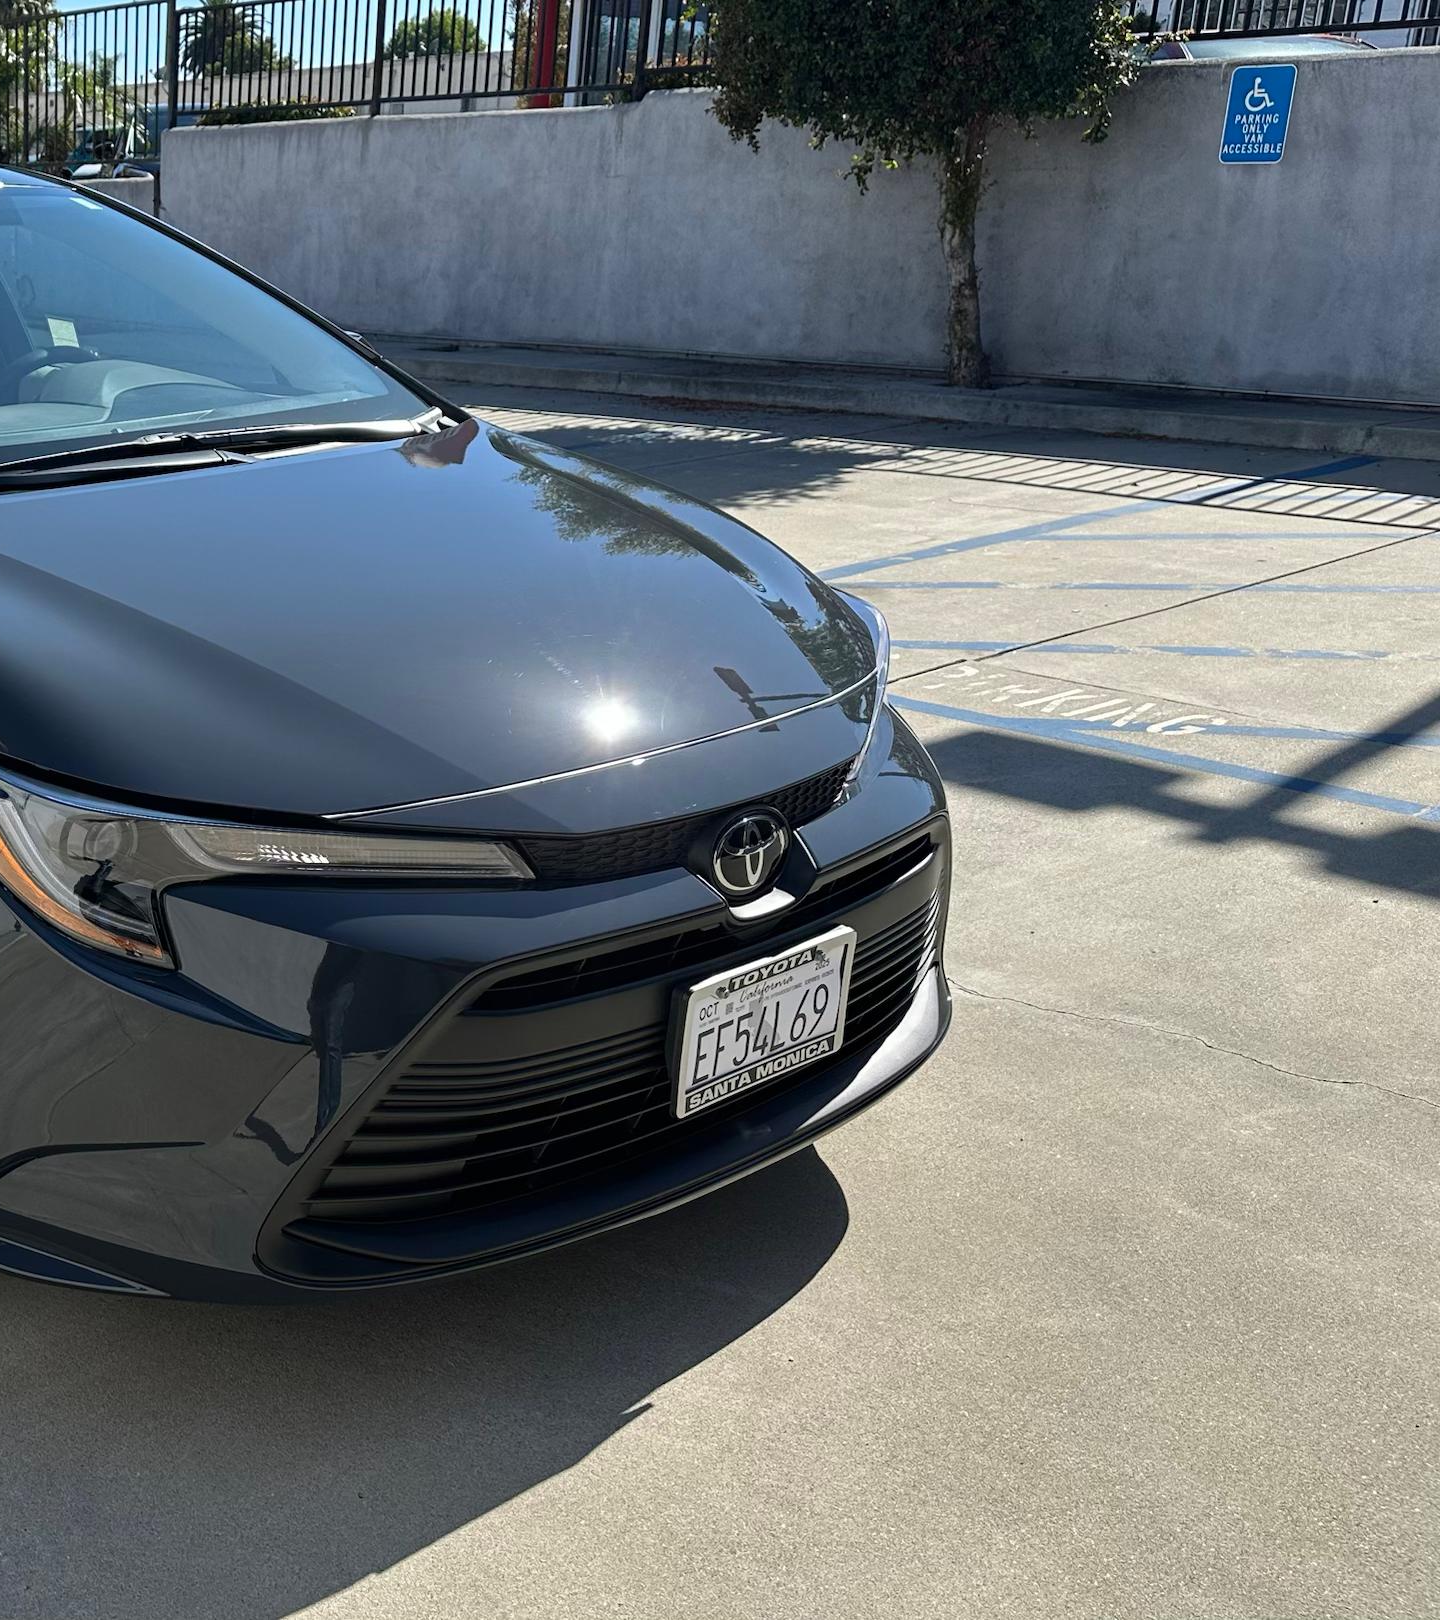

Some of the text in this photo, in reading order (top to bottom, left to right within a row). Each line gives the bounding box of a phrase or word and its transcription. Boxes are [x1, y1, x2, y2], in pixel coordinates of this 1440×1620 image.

[1235, 114, 1279, 124] PARKING
[1242, 124, 1269, 134] ONLY
[1223, 143, 1282, 154] ACCESSIBLE
[1244, 134, 1263, 143] VAN
[731, 950, 812, 990] TOYOTA
[740, 975, 794, 1003] California
[699, 1001, 719, 1021] OCT
[691, 984, 829, 1085] EF54L69
[689, 1039, 830, 1109] SANTA MONICA
